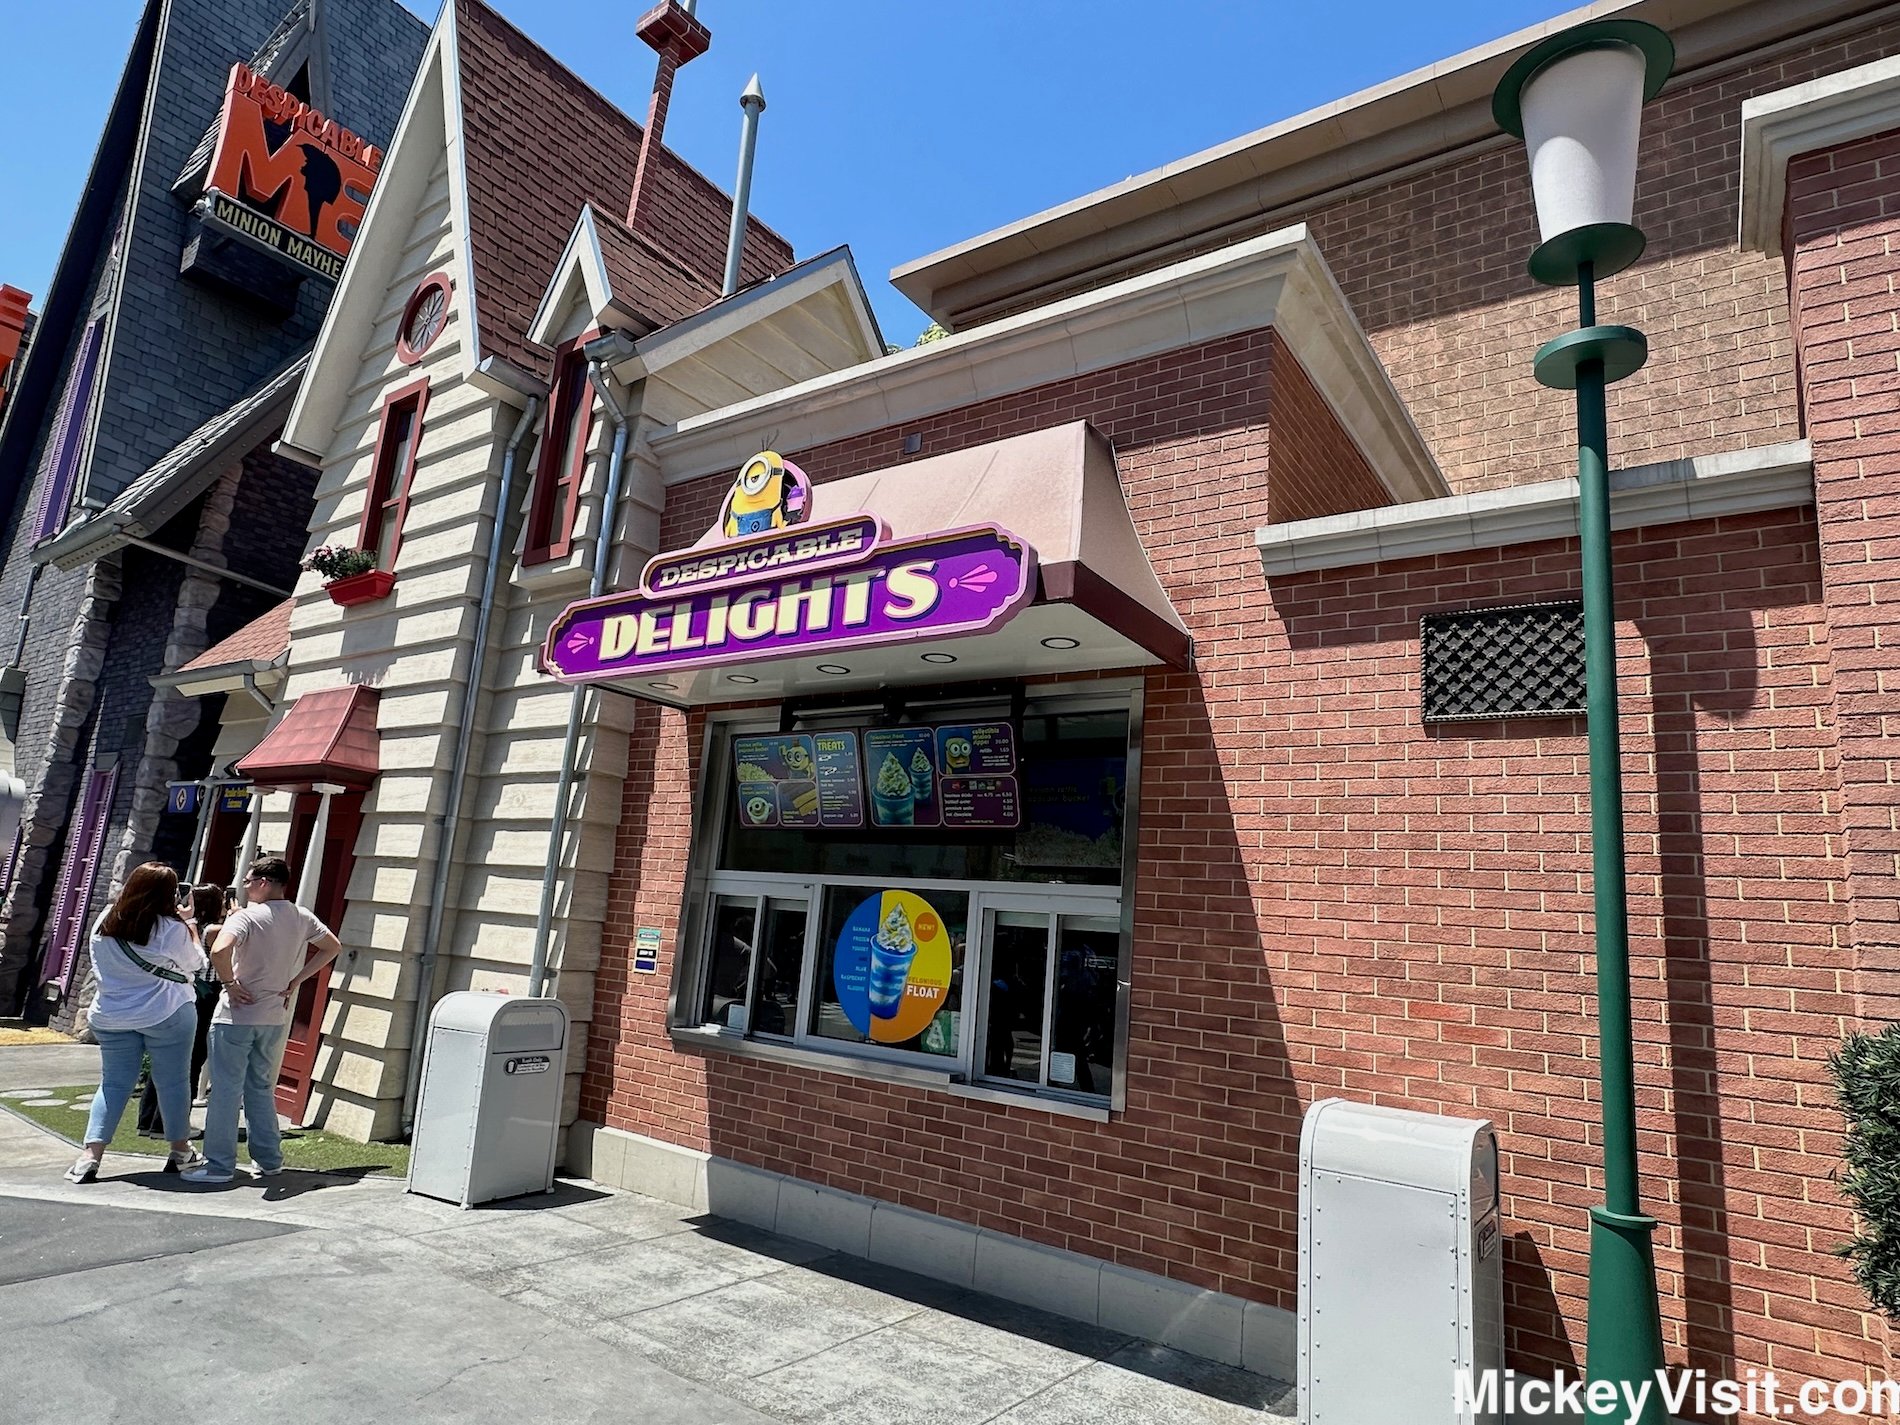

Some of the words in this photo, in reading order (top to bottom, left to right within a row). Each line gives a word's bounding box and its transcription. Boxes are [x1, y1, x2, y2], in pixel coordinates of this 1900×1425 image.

[233, 64, 384, 171] DESPICABLE
[217, 200, 282, 247] MINION
[287, 236, 343, 278] MAYHE
[659, 527, 863, 588] DESPICABLE
[598, 559, 941, 662] DELIGHTS
[817, 740, 846, 751] TREATS
[907, 985, 940, 999] FLOAT
